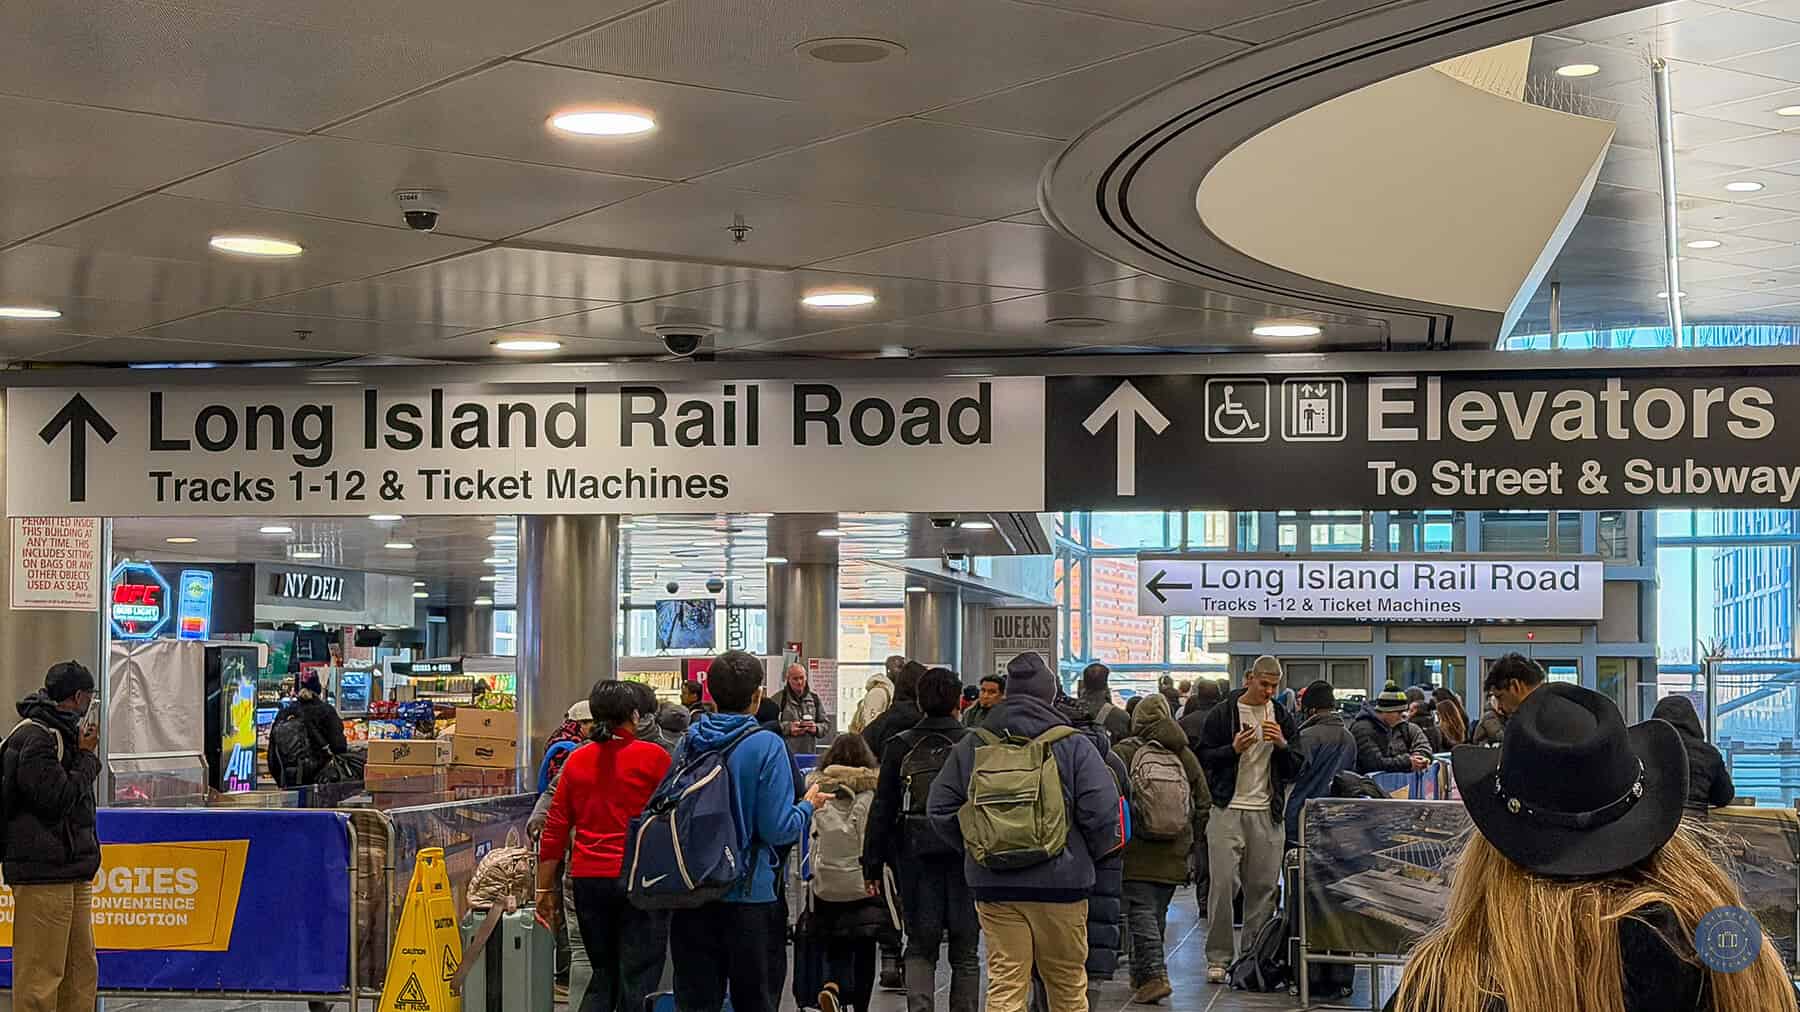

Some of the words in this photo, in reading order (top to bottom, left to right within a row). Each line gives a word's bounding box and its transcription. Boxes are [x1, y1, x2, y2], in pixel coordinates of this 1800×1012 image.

[1367, 376, 1775, 442] Elevators
[149, 391, 334, 468] Long
[364, 387, 587, 449] Island
[620, 384, 759, 447] Rail
[794, 383, 992, 446] Road
[149, 471, 275, 502] Tracks
[289, 471, 365, 501] 1-12
[379, 470, 405, 500] &
[418, 469, 532, 500] Ticket
[547, 469, 729, 499] Machines
[1367, 461, 1417, 496] To
[1431, 461, 1563, 496] Street
[1577, 460, 1609, 495] &
[1623, 458, 1800, 503] Subway
[22, 517, 71, 526] PERMITTED
[22, 527, 42, 536] THIS
[45, 527, 83, 537] BUILDING
[27, 538, 48, 546] ANY
[22, 548, 66, 558] INCLUDES
[22, 559, 37, 568] ON
[40, 559, 64, 569] BAGS
[66, 559, 77, 569] OR
[79, 560, 93, 569] ANY
[27, 570, 57, 579] OTHER
[59, 571, 90, 580] OBJECTS
[1201, 562, 1284, 596] Long
[1298, 563, 1399, 589] Island
[1414, 563, 1475, 590] Rail
[1491, 564, 1580, 591] Road
[27, 581, 51, 590] USED
[53, 581, 65, 590] AS
[283, 573, 308, 598] NY
[309, 575, 345, 601] DELI
[1201, 597, 1257, 612] Tracks
[1263, 597, 1296, 612] 1-12
[1302, 598, 1313, 612] &
[1319, 598, 1371, 612] Ticket
[1378, 598, 1461, 613] Machines
[993, 615, 1051, 638] QUEENS
[91, 897, 195, 911] ONVENIENCE
[92, 912, 188, 926] STRUCTION
